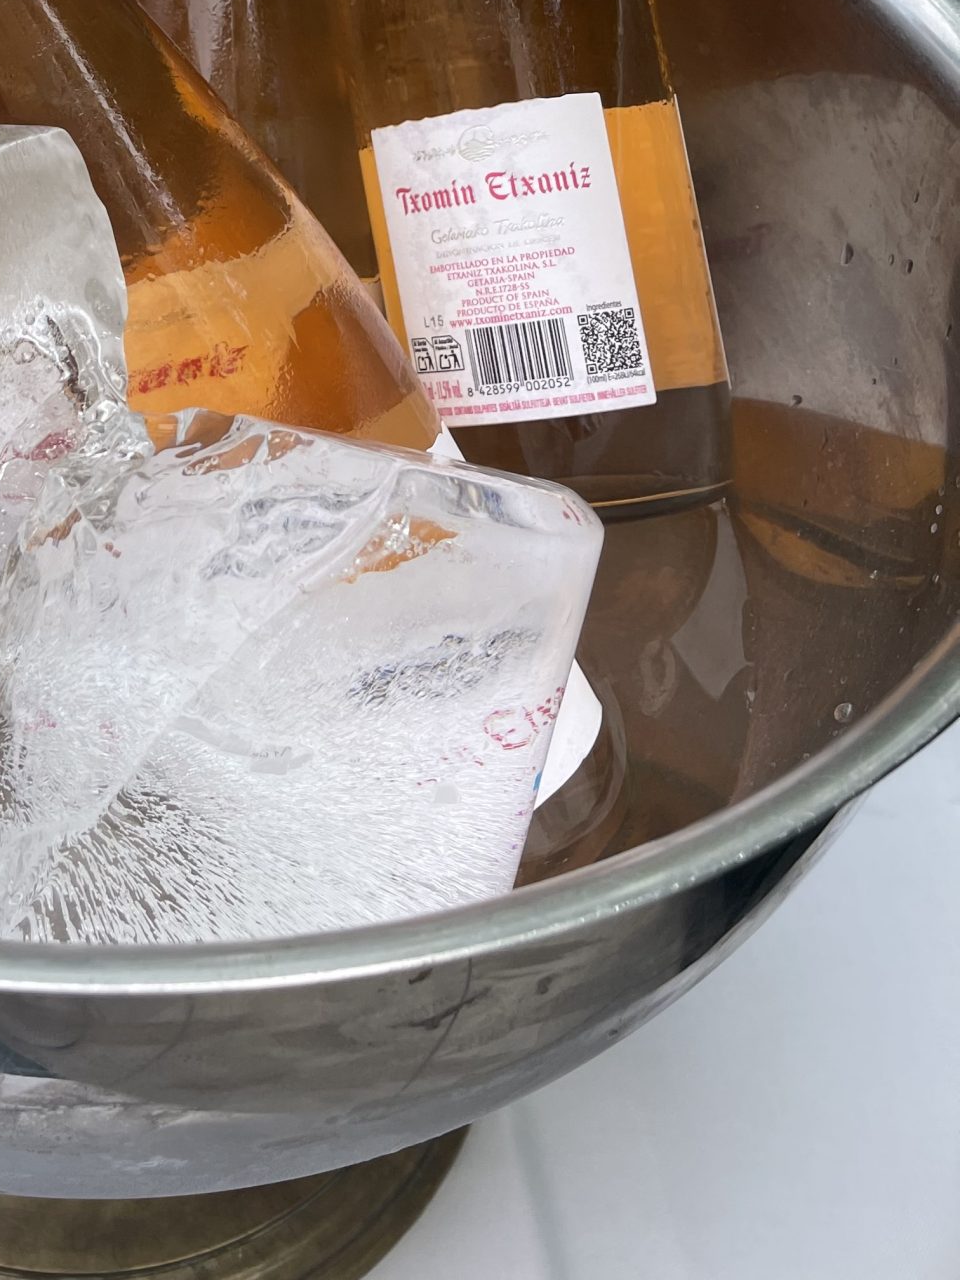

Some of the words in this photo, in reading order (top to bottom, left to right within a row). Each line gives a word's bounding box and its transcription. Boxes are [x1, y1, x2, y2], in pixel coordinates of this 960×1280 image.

[396, 180, 476, 216] Txomin
[485, 161, 592, 201] Etxaniz
[431, 222, 489, 245] Getariako
[430, 259, 489, 274] EMBOTELLADO
[491, 256, 504, 265] EN
[506, 254, 519, 263] LA
[519, 247, 575, 261] PROPIEDAD
[447, 270, 483, 281] ETXANIZ
[467, 272, 535, 288] GETARIA-SPAIN
[456, 304, 506, 317] PRODUCTO
[508, 302, 521, 311] DE
[524, 297, 560, 310] ESPAÑA
[461, 296, 504, 308] PRODUCT
[506, 292, 519, 302] OF
[521, 289, 550, 299] SPAIN
[449, 305, 573, 329] www.txominetxaniz.com
[467, 387, 474, 397] 8
[480, 383, 520, 396] 428599
[525, 377, 571, 391] 002052
